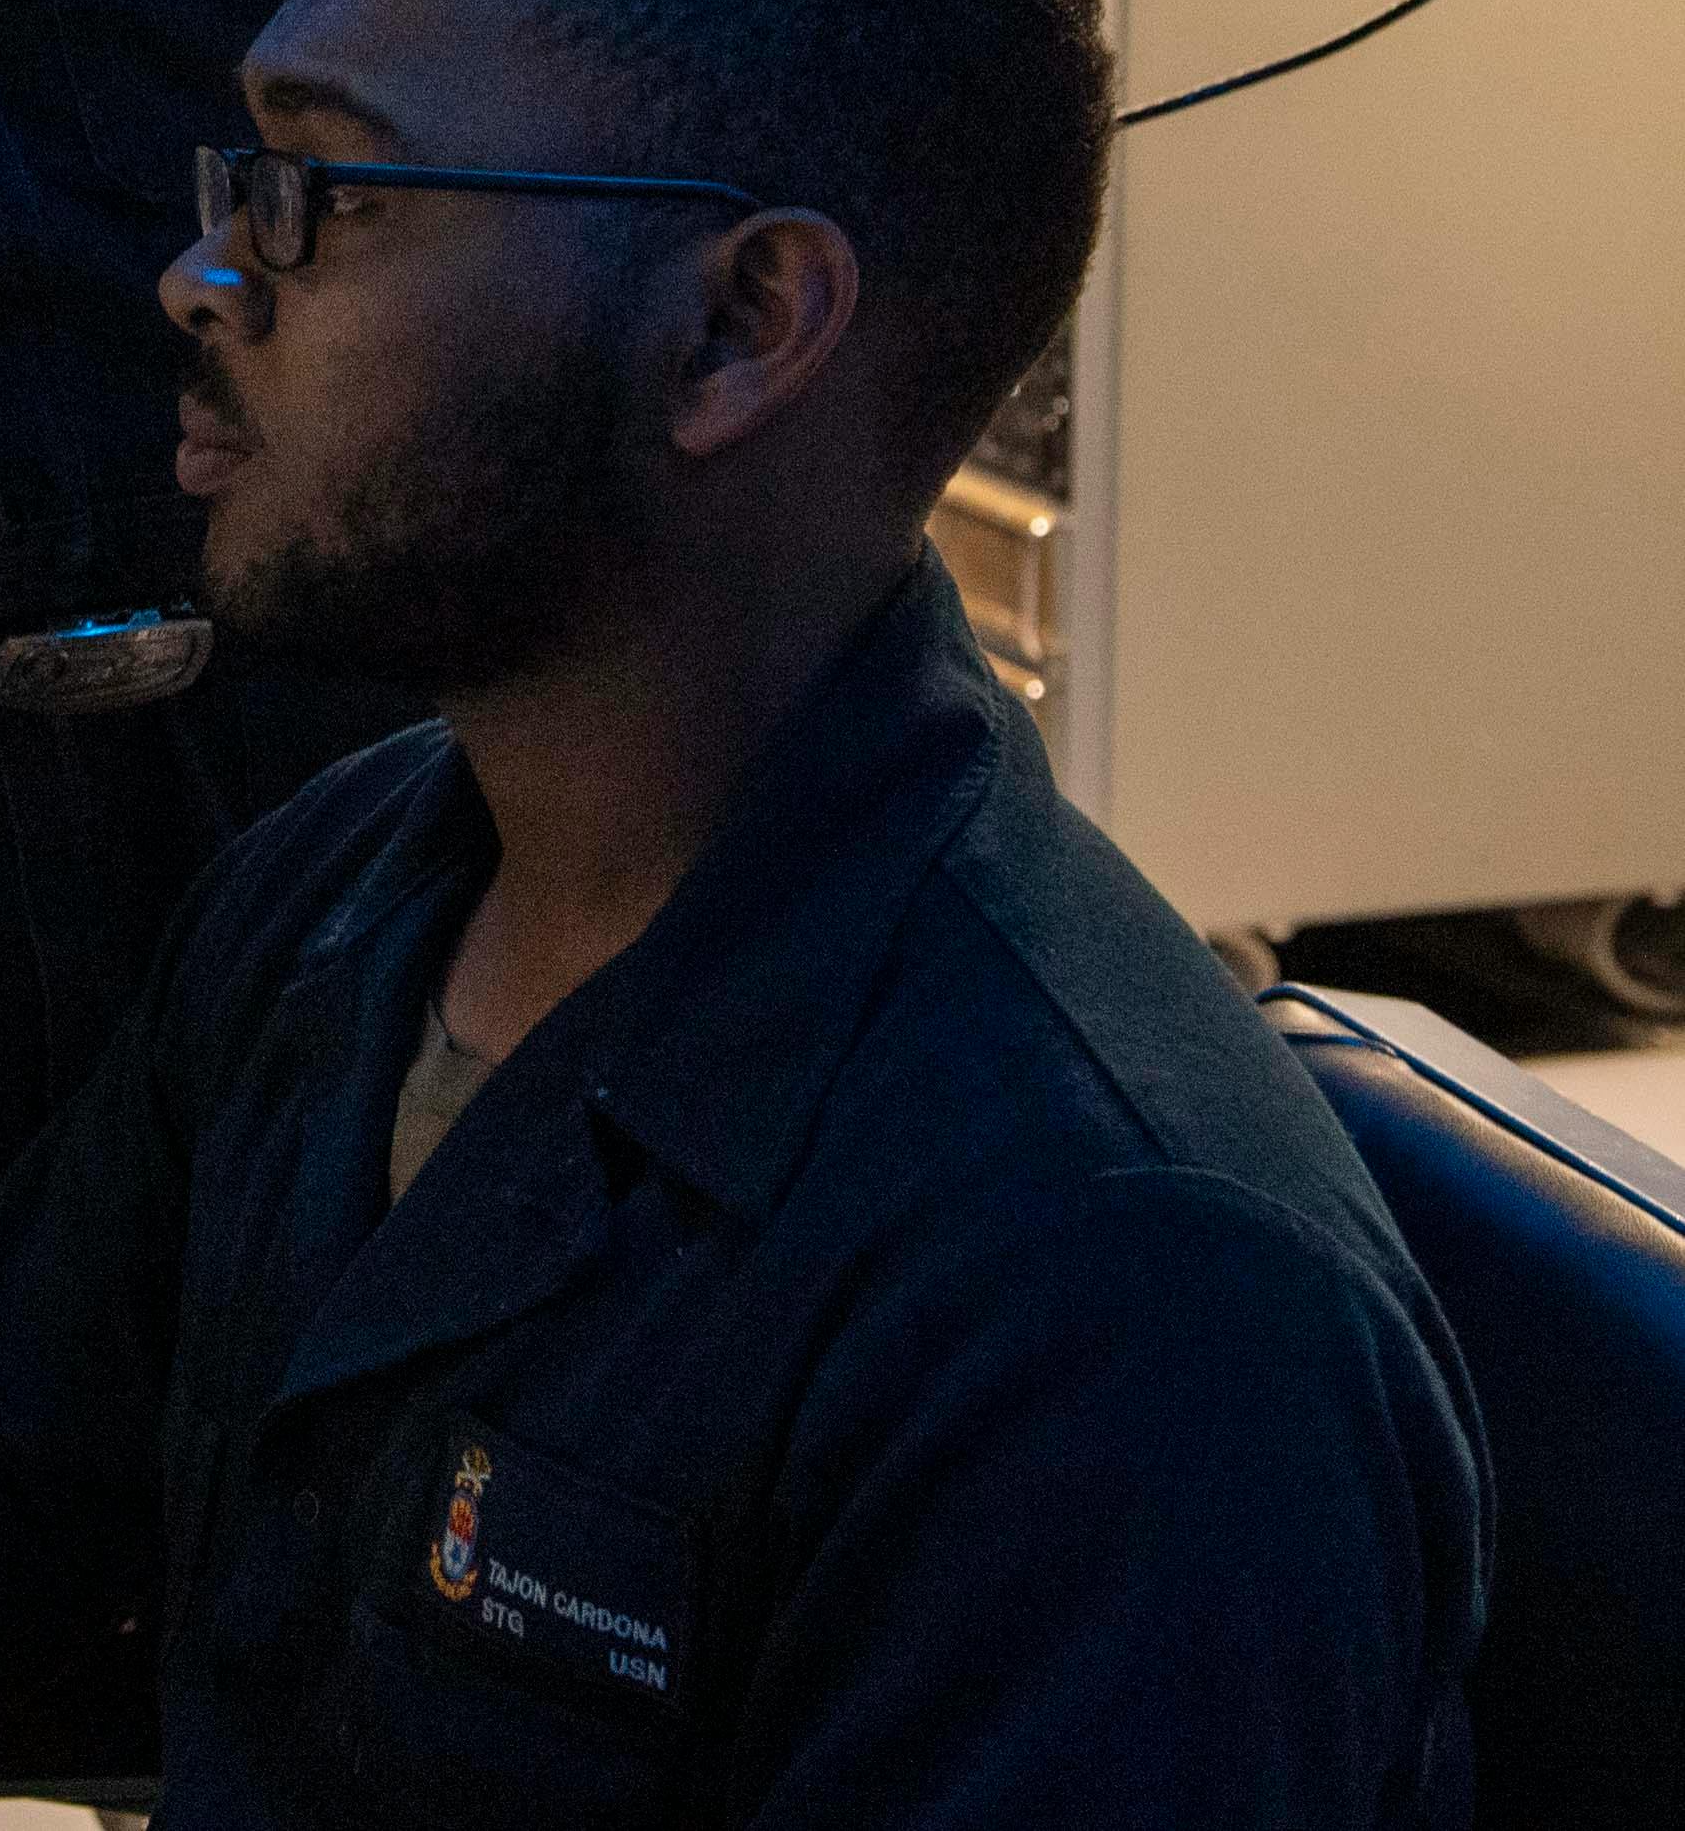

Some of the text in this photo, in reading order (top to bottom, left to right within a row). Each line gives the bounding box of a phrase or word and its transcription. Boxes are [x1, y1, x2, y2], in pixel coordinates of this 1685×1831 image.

[488, 1557, 547, 1609] TAJON
[553, 1590, 668, 1652] CARDONA
[609, 1648, 667, 1691] USN
